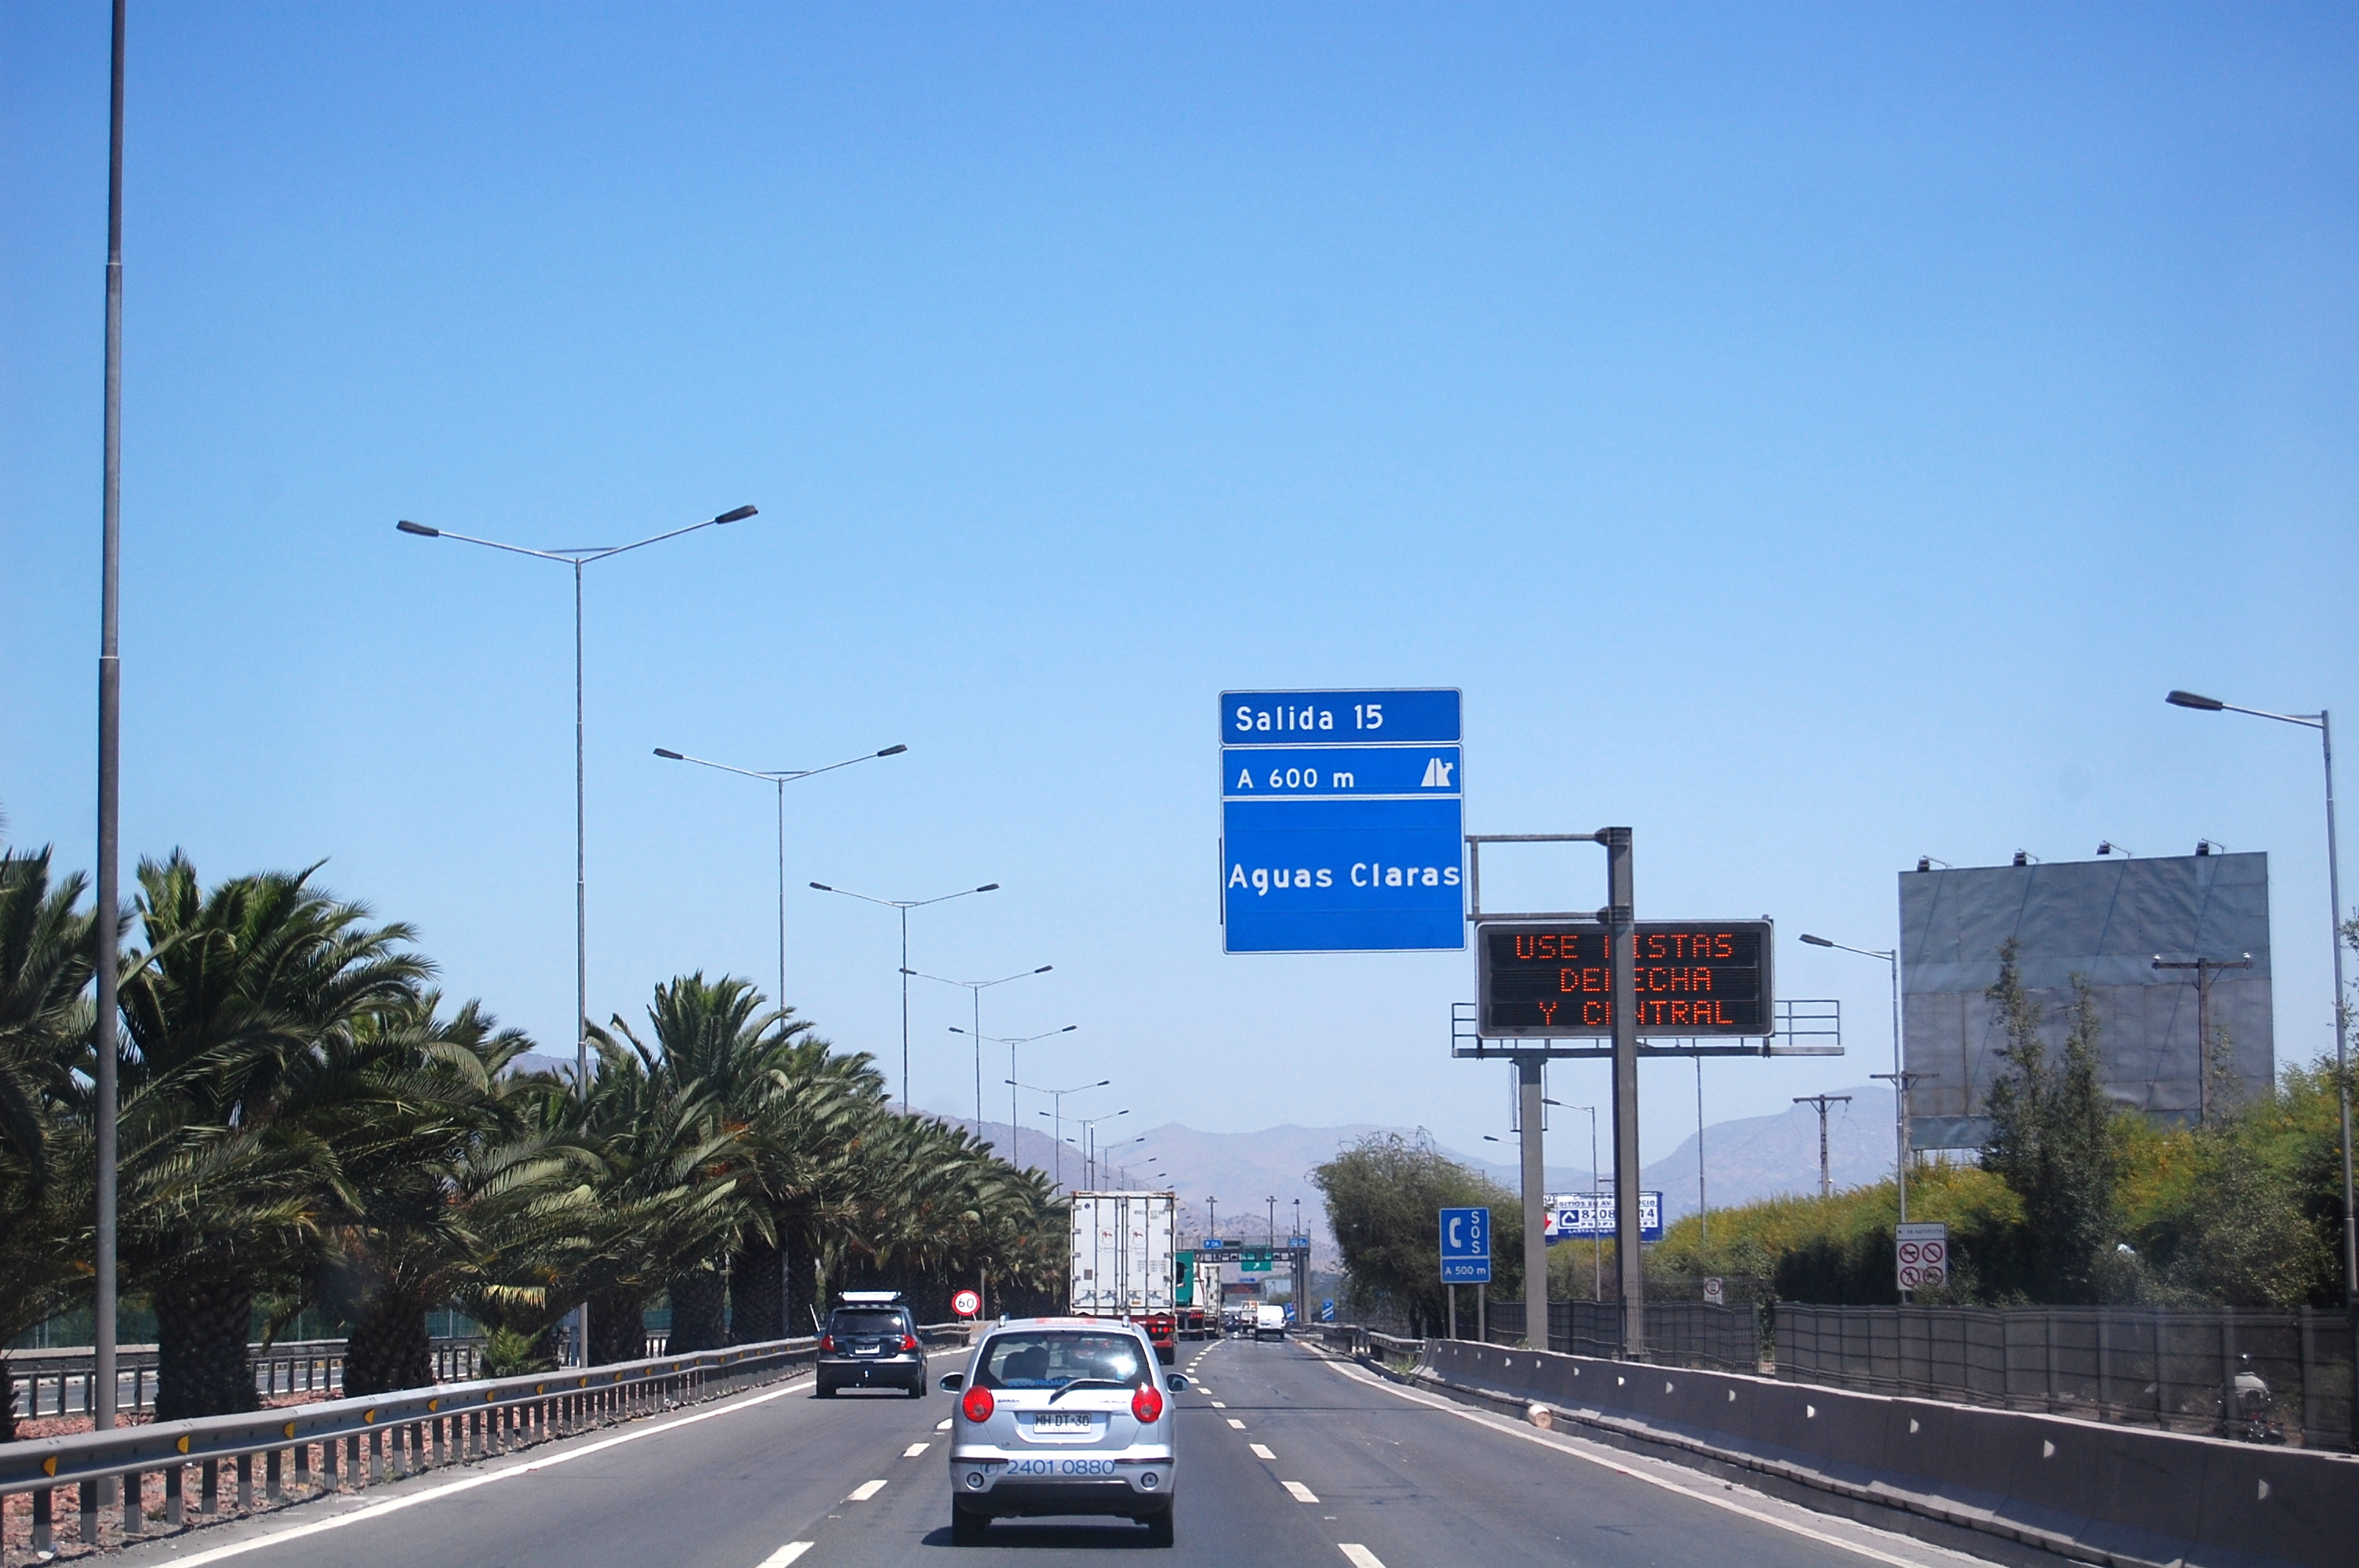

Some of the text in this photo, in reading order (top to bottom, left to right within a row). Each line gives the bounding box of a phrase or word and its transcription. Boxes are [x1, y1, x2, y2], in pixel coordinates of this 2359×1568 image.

[1236, 704, 1383, 731] Salida 15
[1237, 768, 1354, 789] A 600 m
[1228, 862, 1460, 897] Aguas Claras
[1516, 935, 1579, 959] USE
[1539, 1002, 1558, 1025] Y
[1470, 1210, 1481, 1254] SOS
[1455, 1266, 1474, 1275] 500
[958, 1298, 975, 1308] 60
[1007, 1459, 1114, 1475] 2401 0880
